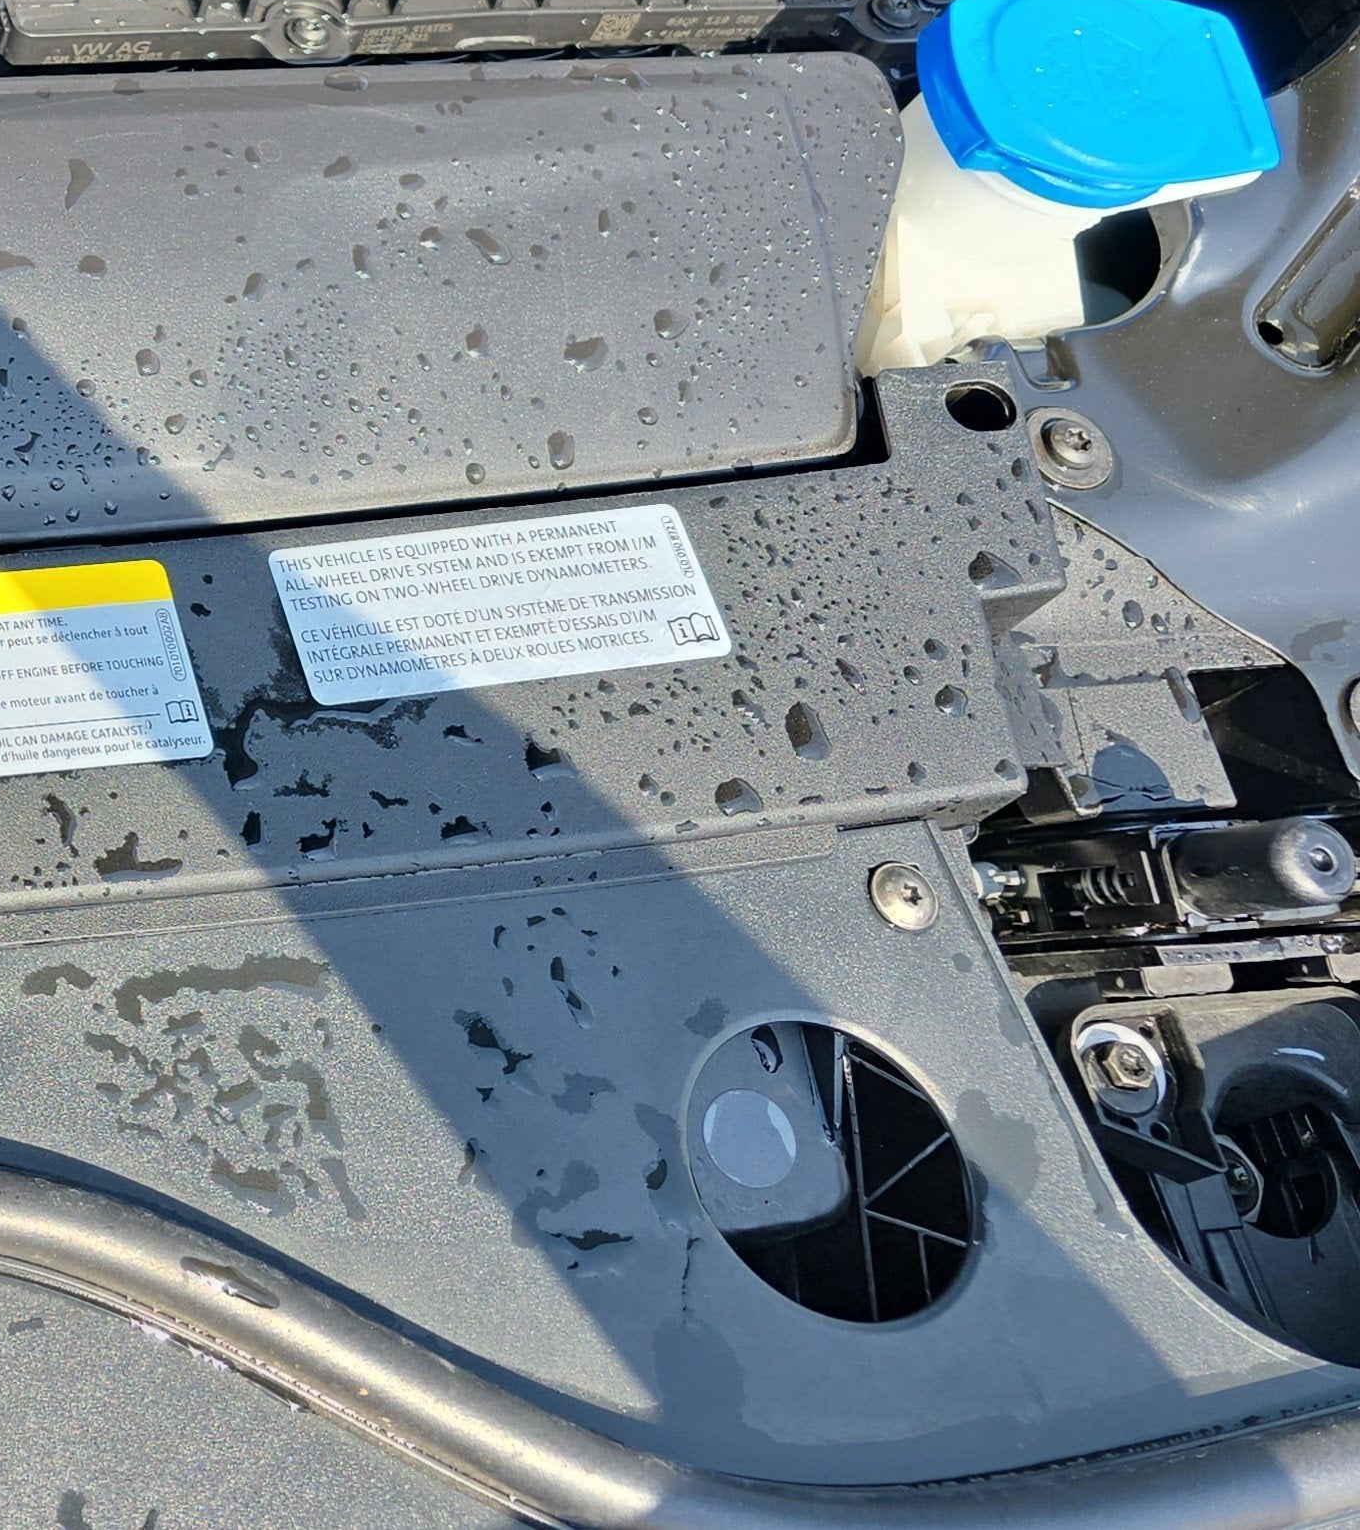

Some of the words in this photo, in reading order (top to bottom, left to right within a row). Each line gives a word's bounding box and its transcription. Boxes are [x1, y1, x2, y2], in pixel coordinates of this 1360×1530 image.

[72, 41, 113, 56] VW
[115, 40, 152, 54] AG
[275, 557, 312, 573] THIS
[312, 549, 377, 568] VEHICLE
[378, 547, 393, 561] IS
[394, 538, 470, 560] EQUIPPED
[470, 533, 513, 549] WITH
[516, 531, 528, 545] A
[528, 520, 617, 543] PERMANENT
[285, 571, 368, 593] ALL-WHEEL
[368, 564, 415, 582] DRIVE
[416, 557, 473, 576] SYSTEM
[476, 553, 509, 569] AND
[510, 551, 526, 565] IS
[527, 544, 583, 563] EXEMPT
[586, 538, 630, 556] FROM
[631, 535, 657, 551] I/M
[288, 592, 353, 612] TESTING
[355, 589, 381, 604] ON
[380, 577, 478, 600] TWO-WHEEL
[478, 571, 525, 589] DRIVE
[526, 556, 652, 583] DYNAMOMETERS.
[13, 619, 35, 631] ANY
[36, 616, 68, 629] TIME.
[16, 665, 59, 679] ENGINE
[60, 661, 105, 675] BEFORE
[104, 655, 165, 671] TOUCHING
[14, 734, 38, 747] CAN
[40, 729, 89, 745] DAMAGE
